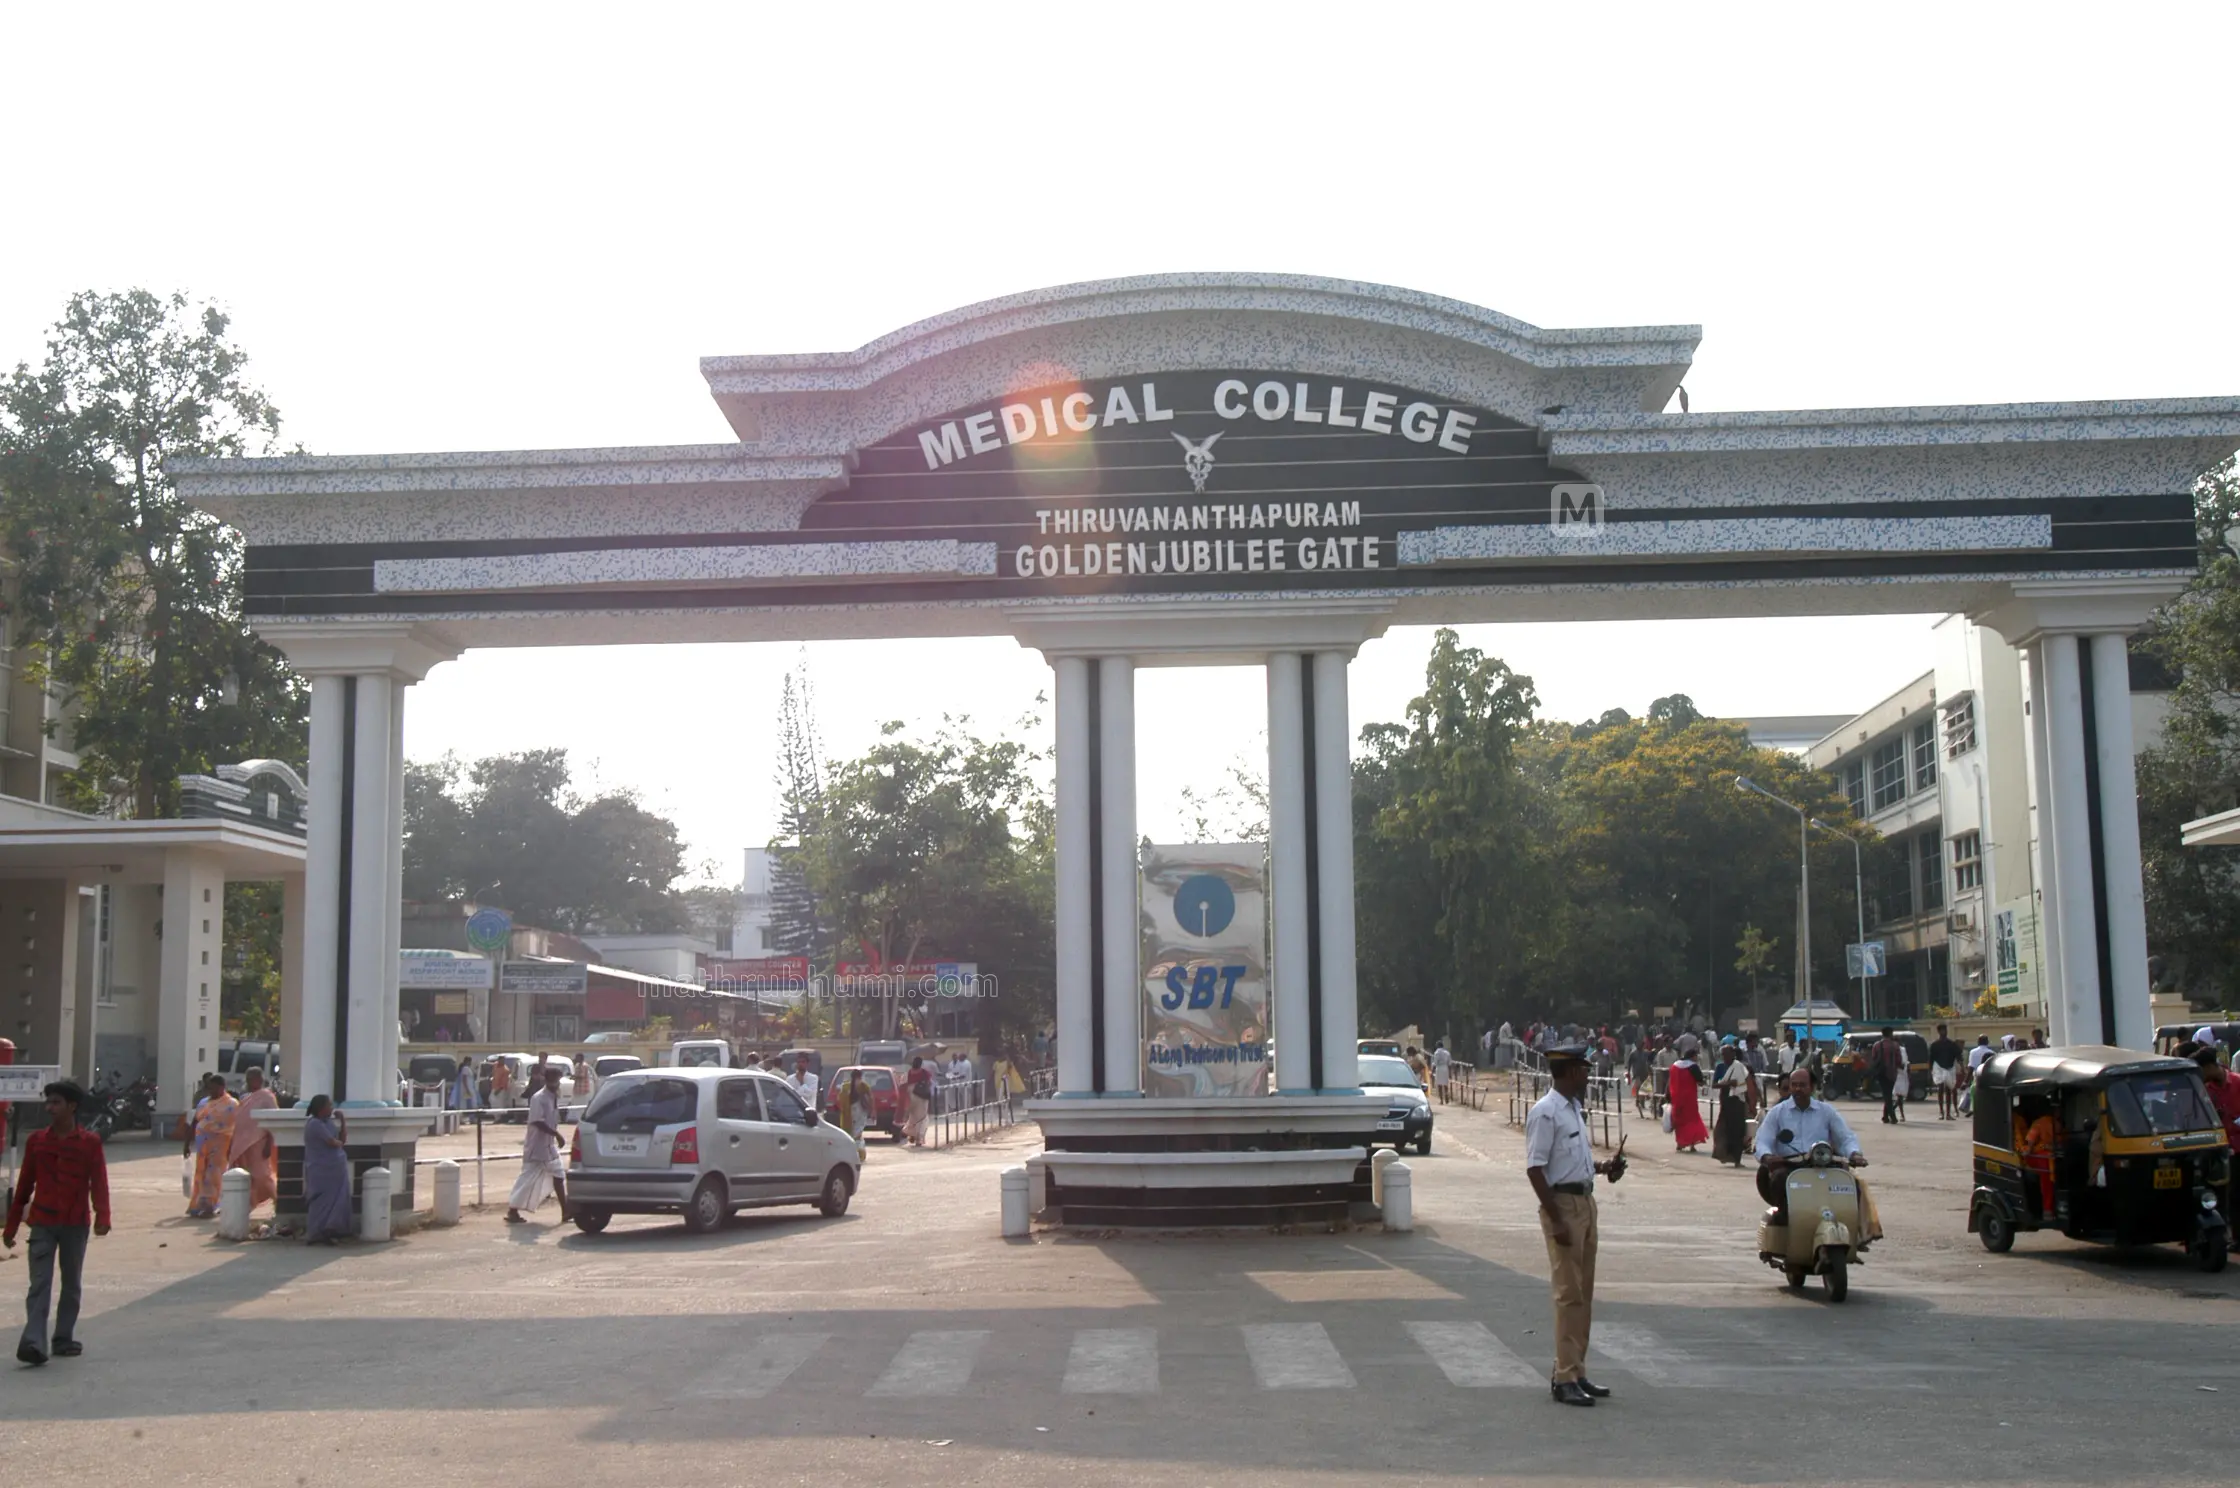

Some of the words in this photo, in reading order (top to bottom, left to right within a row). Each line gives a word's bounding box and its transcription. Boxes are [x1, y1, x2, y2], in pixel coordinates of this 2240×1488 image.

[918, 382, 1174, 471] MEDICAL
[1213, 379, 1478, 455] COLLEGE
[1036, 501, 1361, 534] THIRUVANANTHAPURAM
[1298, 536, 1380, 570] GATE
[1161, 965, 1247, 1011] SBT
[1149, 1044, 1157, 1064] A
[1158, 1044, 1182, 1067] Long
[1183, 1043, 1225, 1065] Tradition
